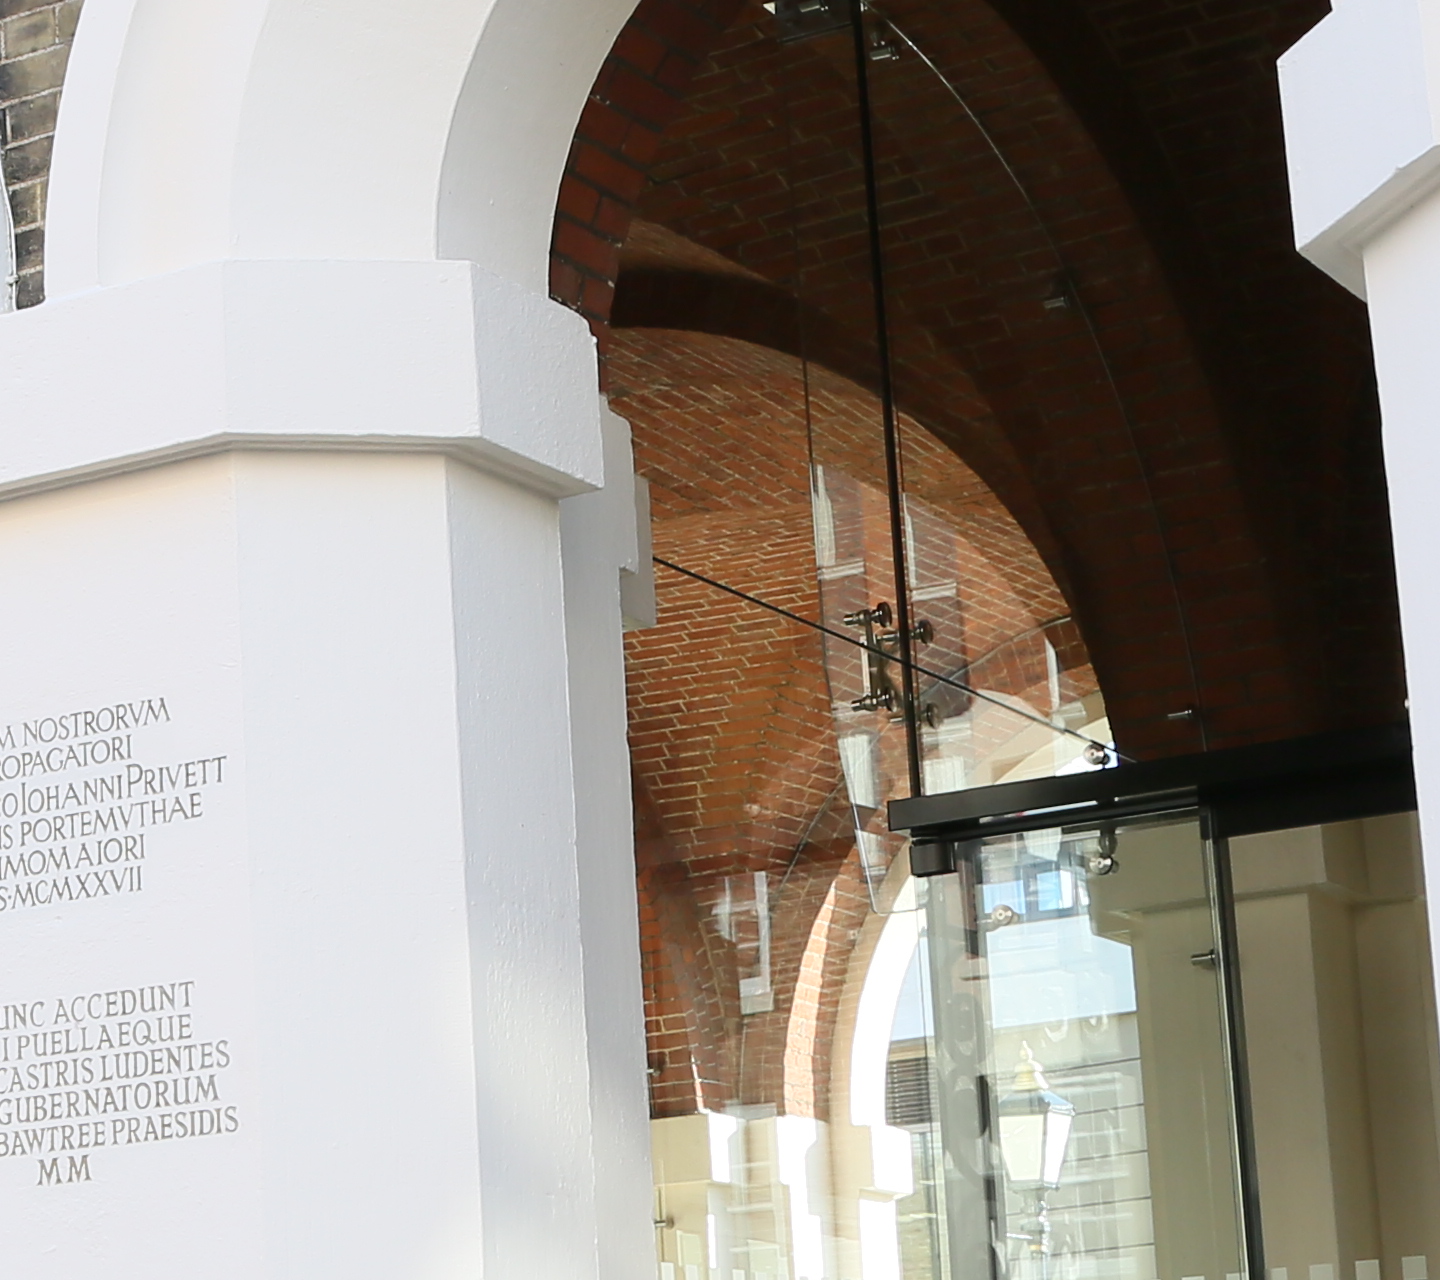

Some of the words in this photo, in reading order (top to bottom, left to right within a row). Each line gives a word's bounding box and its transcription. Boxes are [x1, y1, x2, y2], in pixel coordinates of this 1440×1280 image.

[23, 697, 170, 746] NOSTRORVM
[20, 792, 203, 847] PORTEMVTHAE
[53, 980, 195, 1025] ACCEDUNT
[17, 1014, 193, 1060] PUELLAEQUE
[100, 1040, 231, 1082] LUDENTES
[111, 1106, 239, 1146] PRAESIDIS
